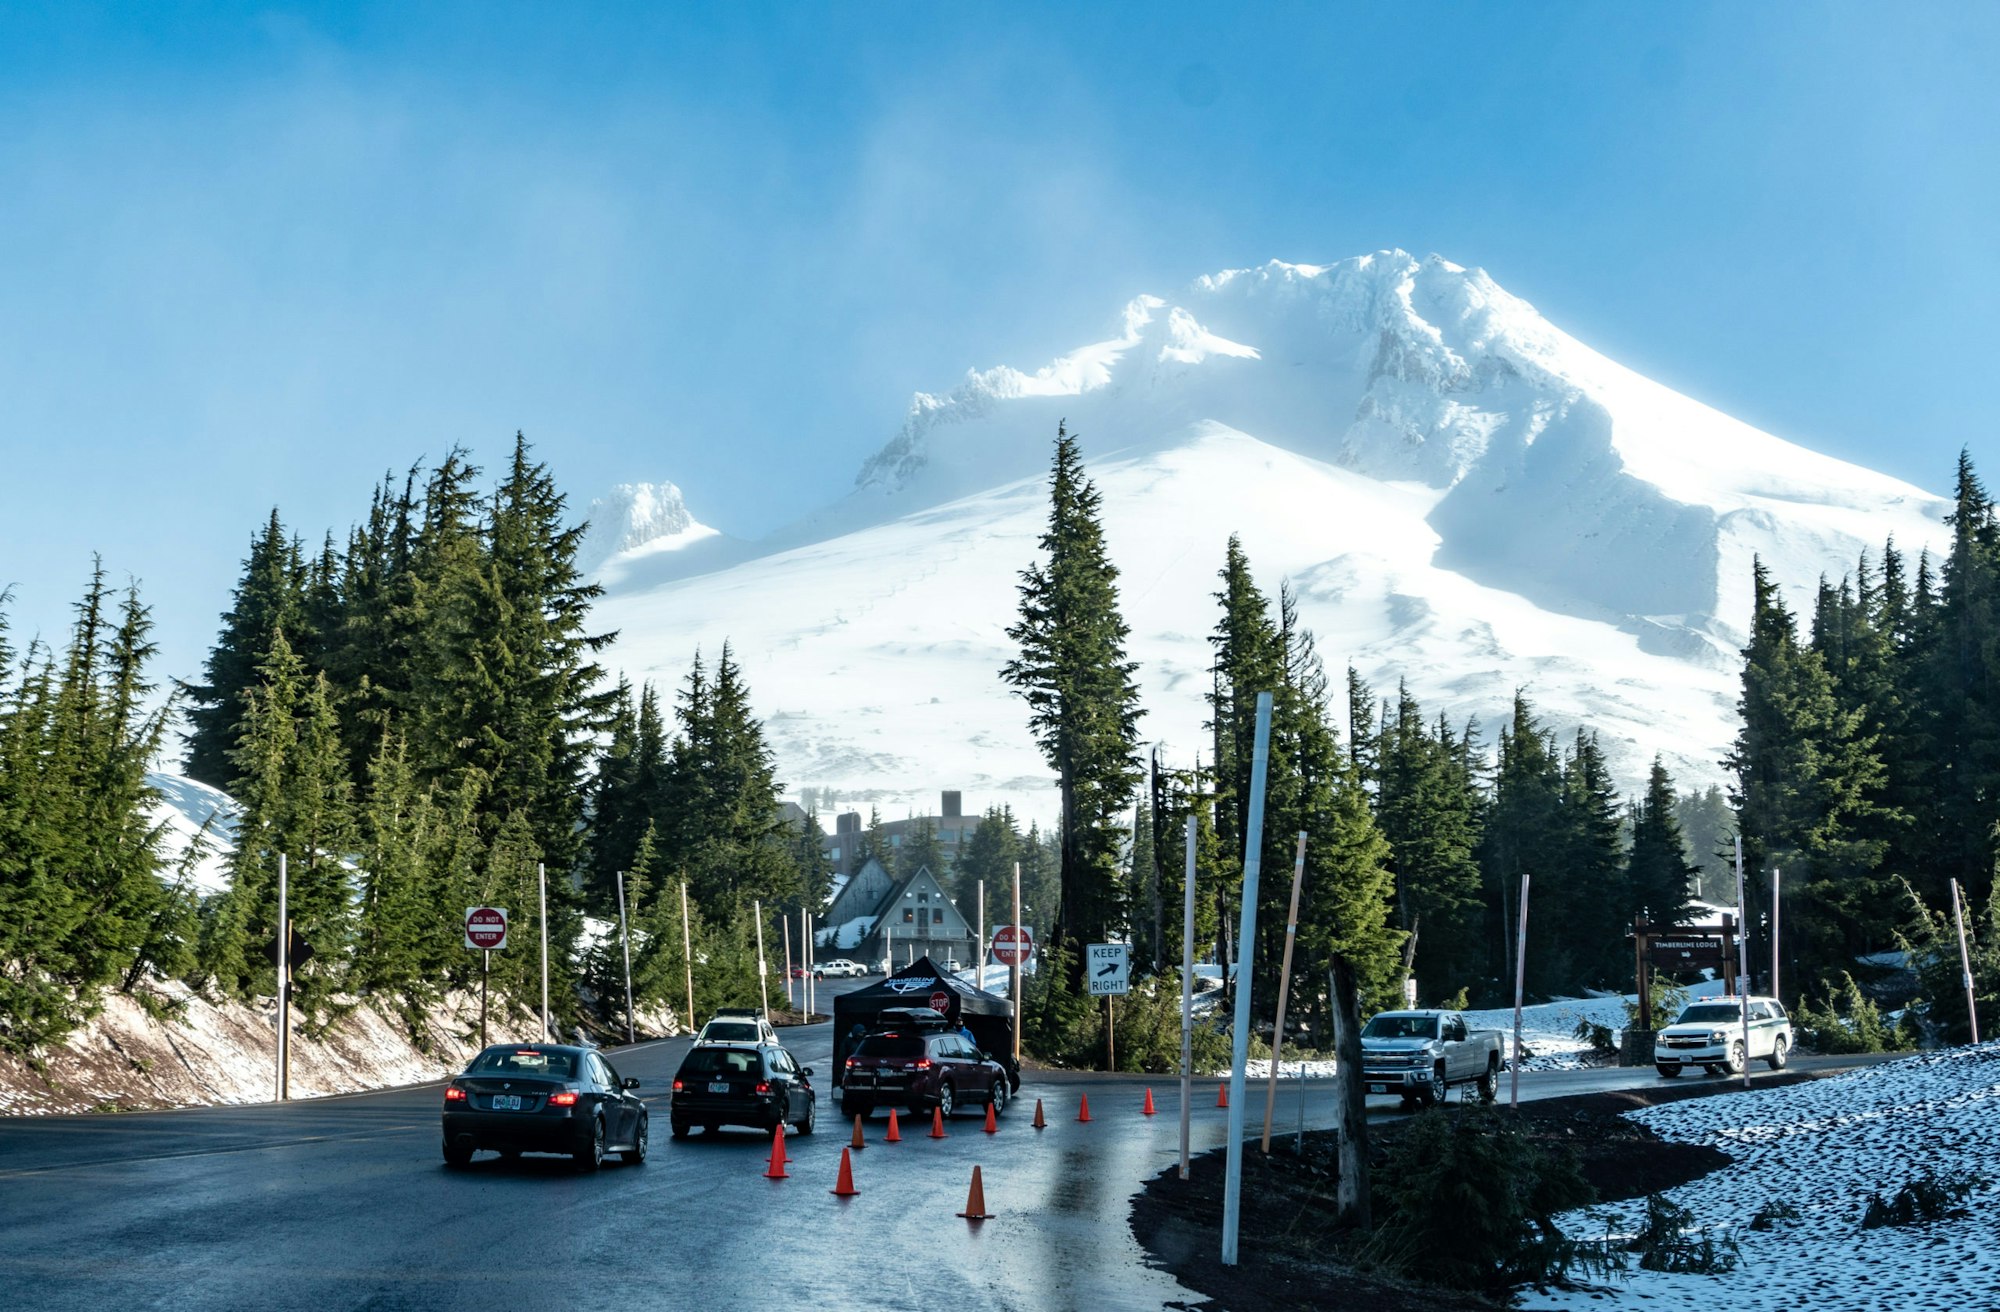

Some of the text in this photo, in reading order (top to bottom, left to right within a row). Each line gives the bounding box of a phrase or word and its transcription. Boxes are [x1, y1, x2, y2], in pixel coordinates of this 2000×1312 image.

[1093, 948, 1121, 958] KEEP
[1092, 980, 1124, 991] RIGHT
[930, 998, 948, 1008] STOP
